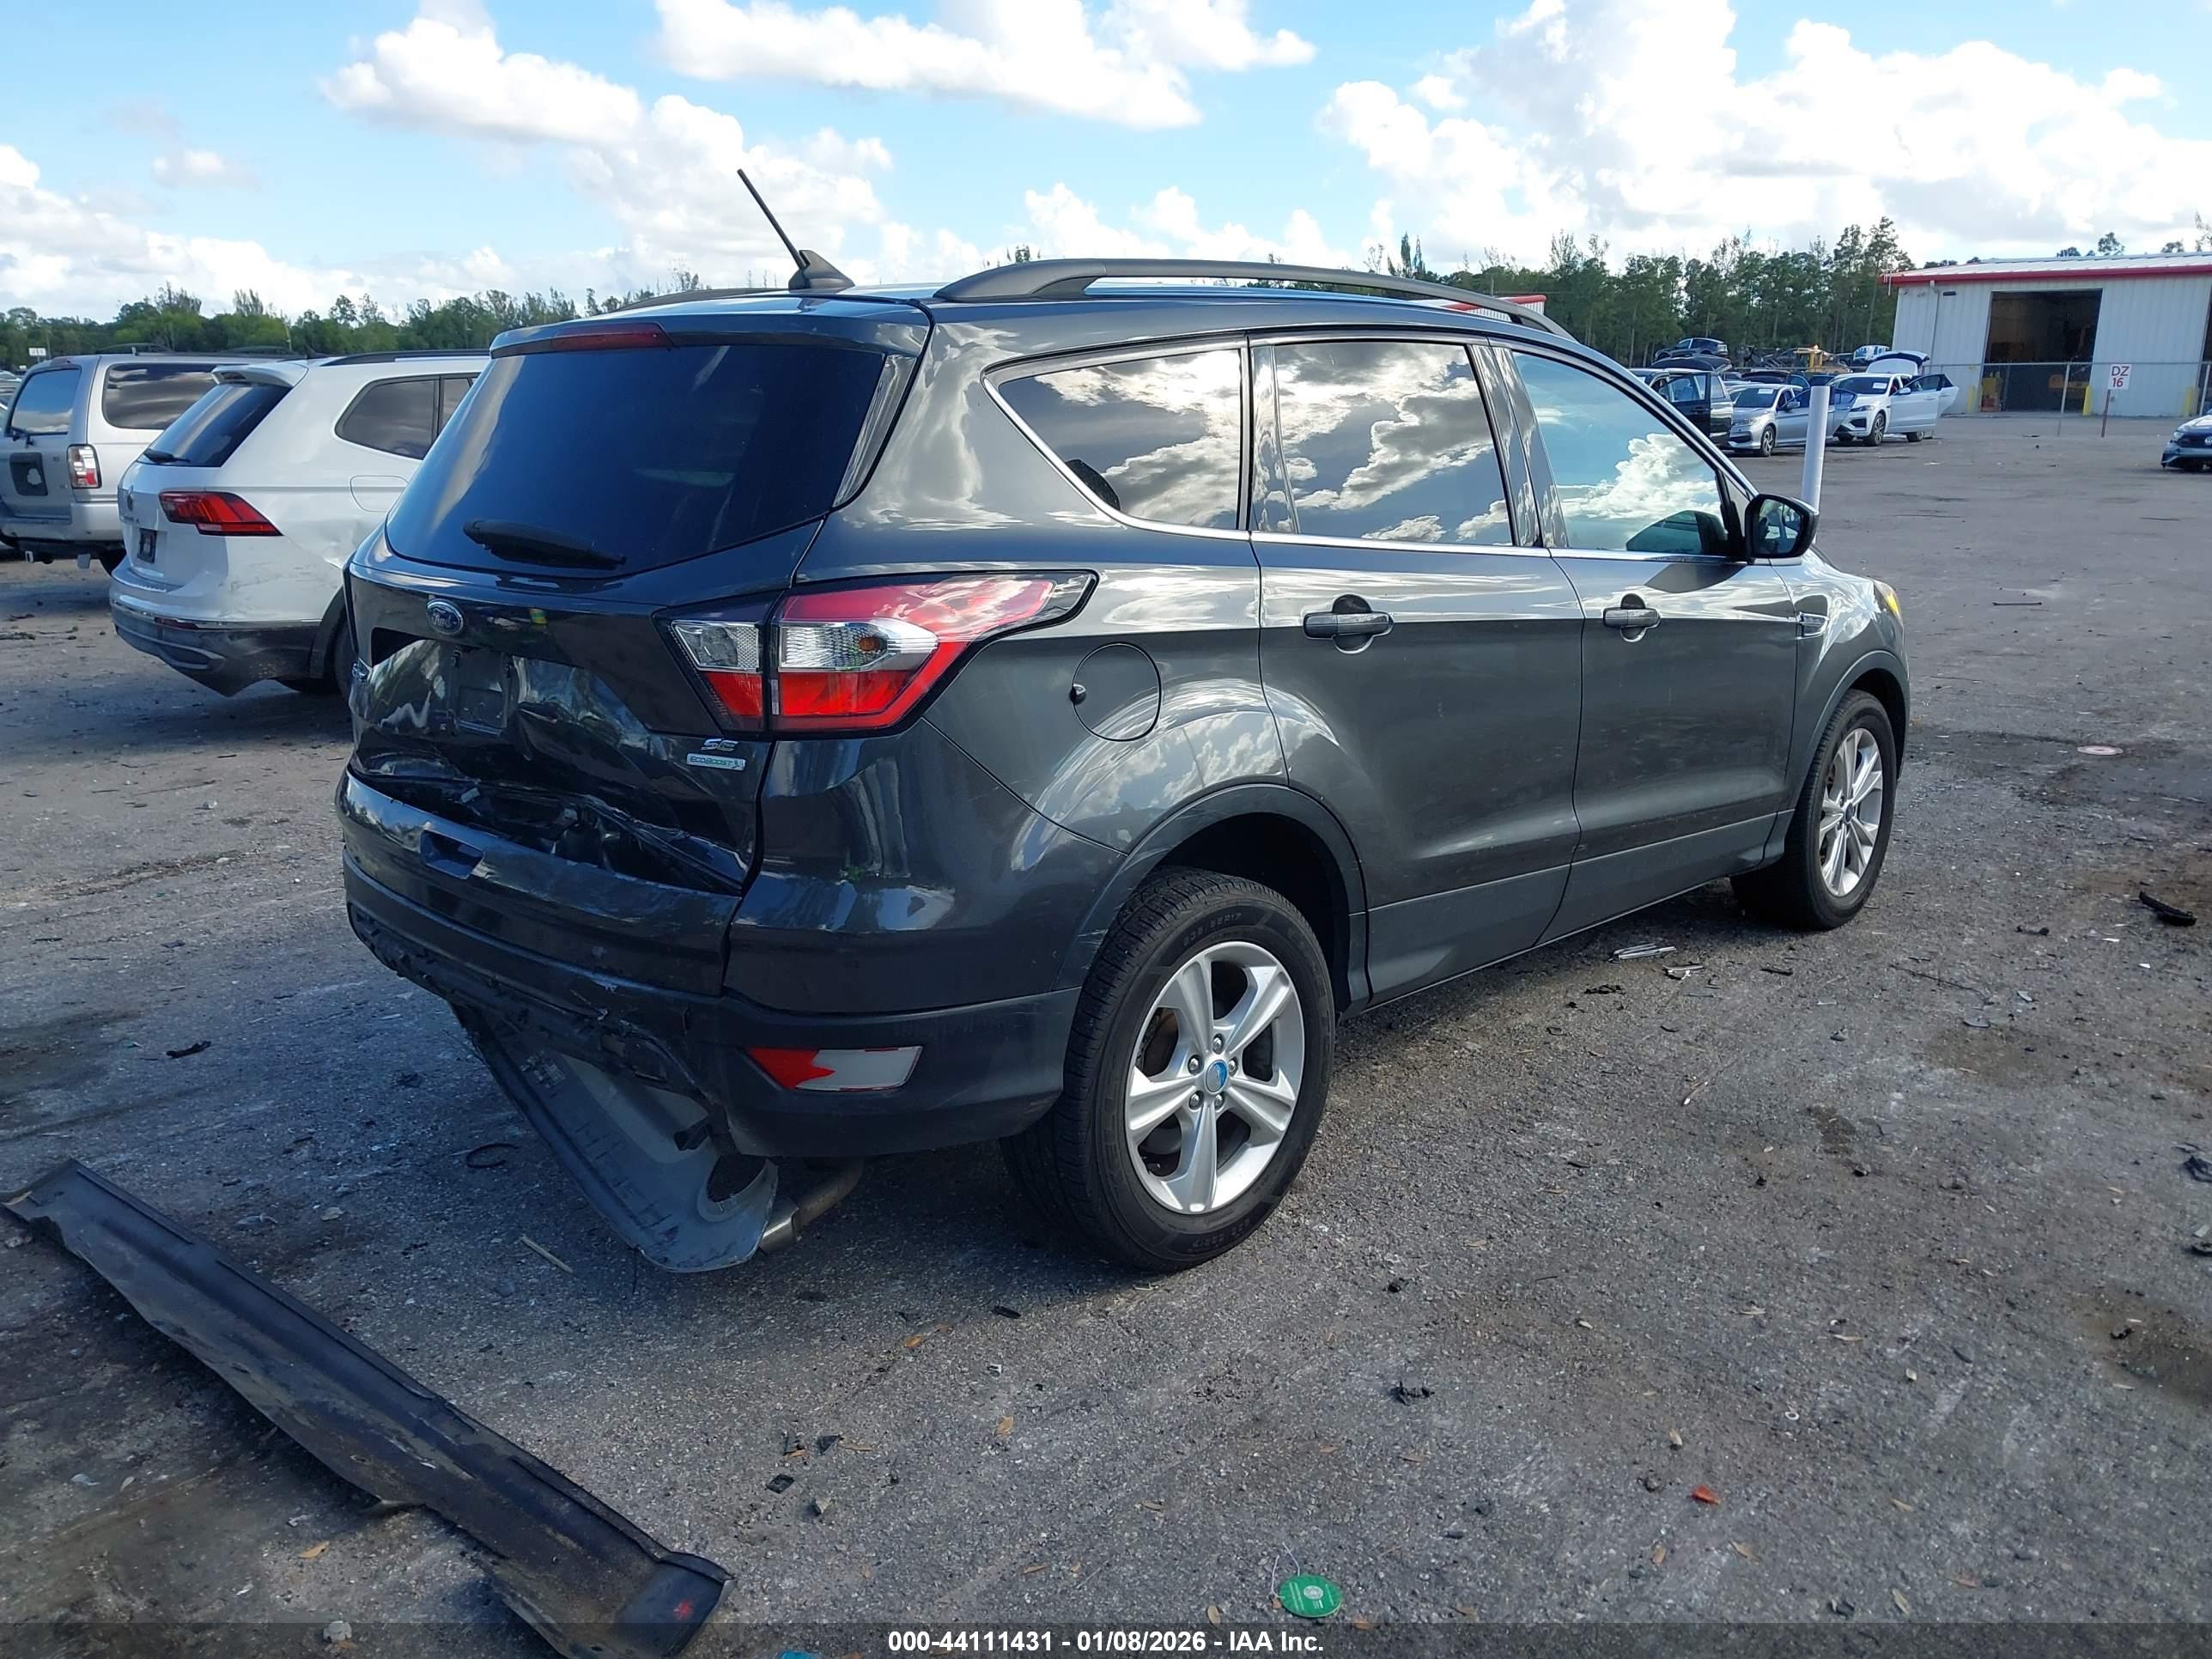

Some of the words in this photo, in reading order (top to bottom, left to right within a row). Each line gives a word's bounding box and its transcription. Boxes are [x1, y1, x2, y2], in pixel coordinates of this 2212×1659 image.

[2112, 366, 2130, 377] DZ
[2112, 377, 2124, 388] 16
[701, 738, 739, 752] SE
